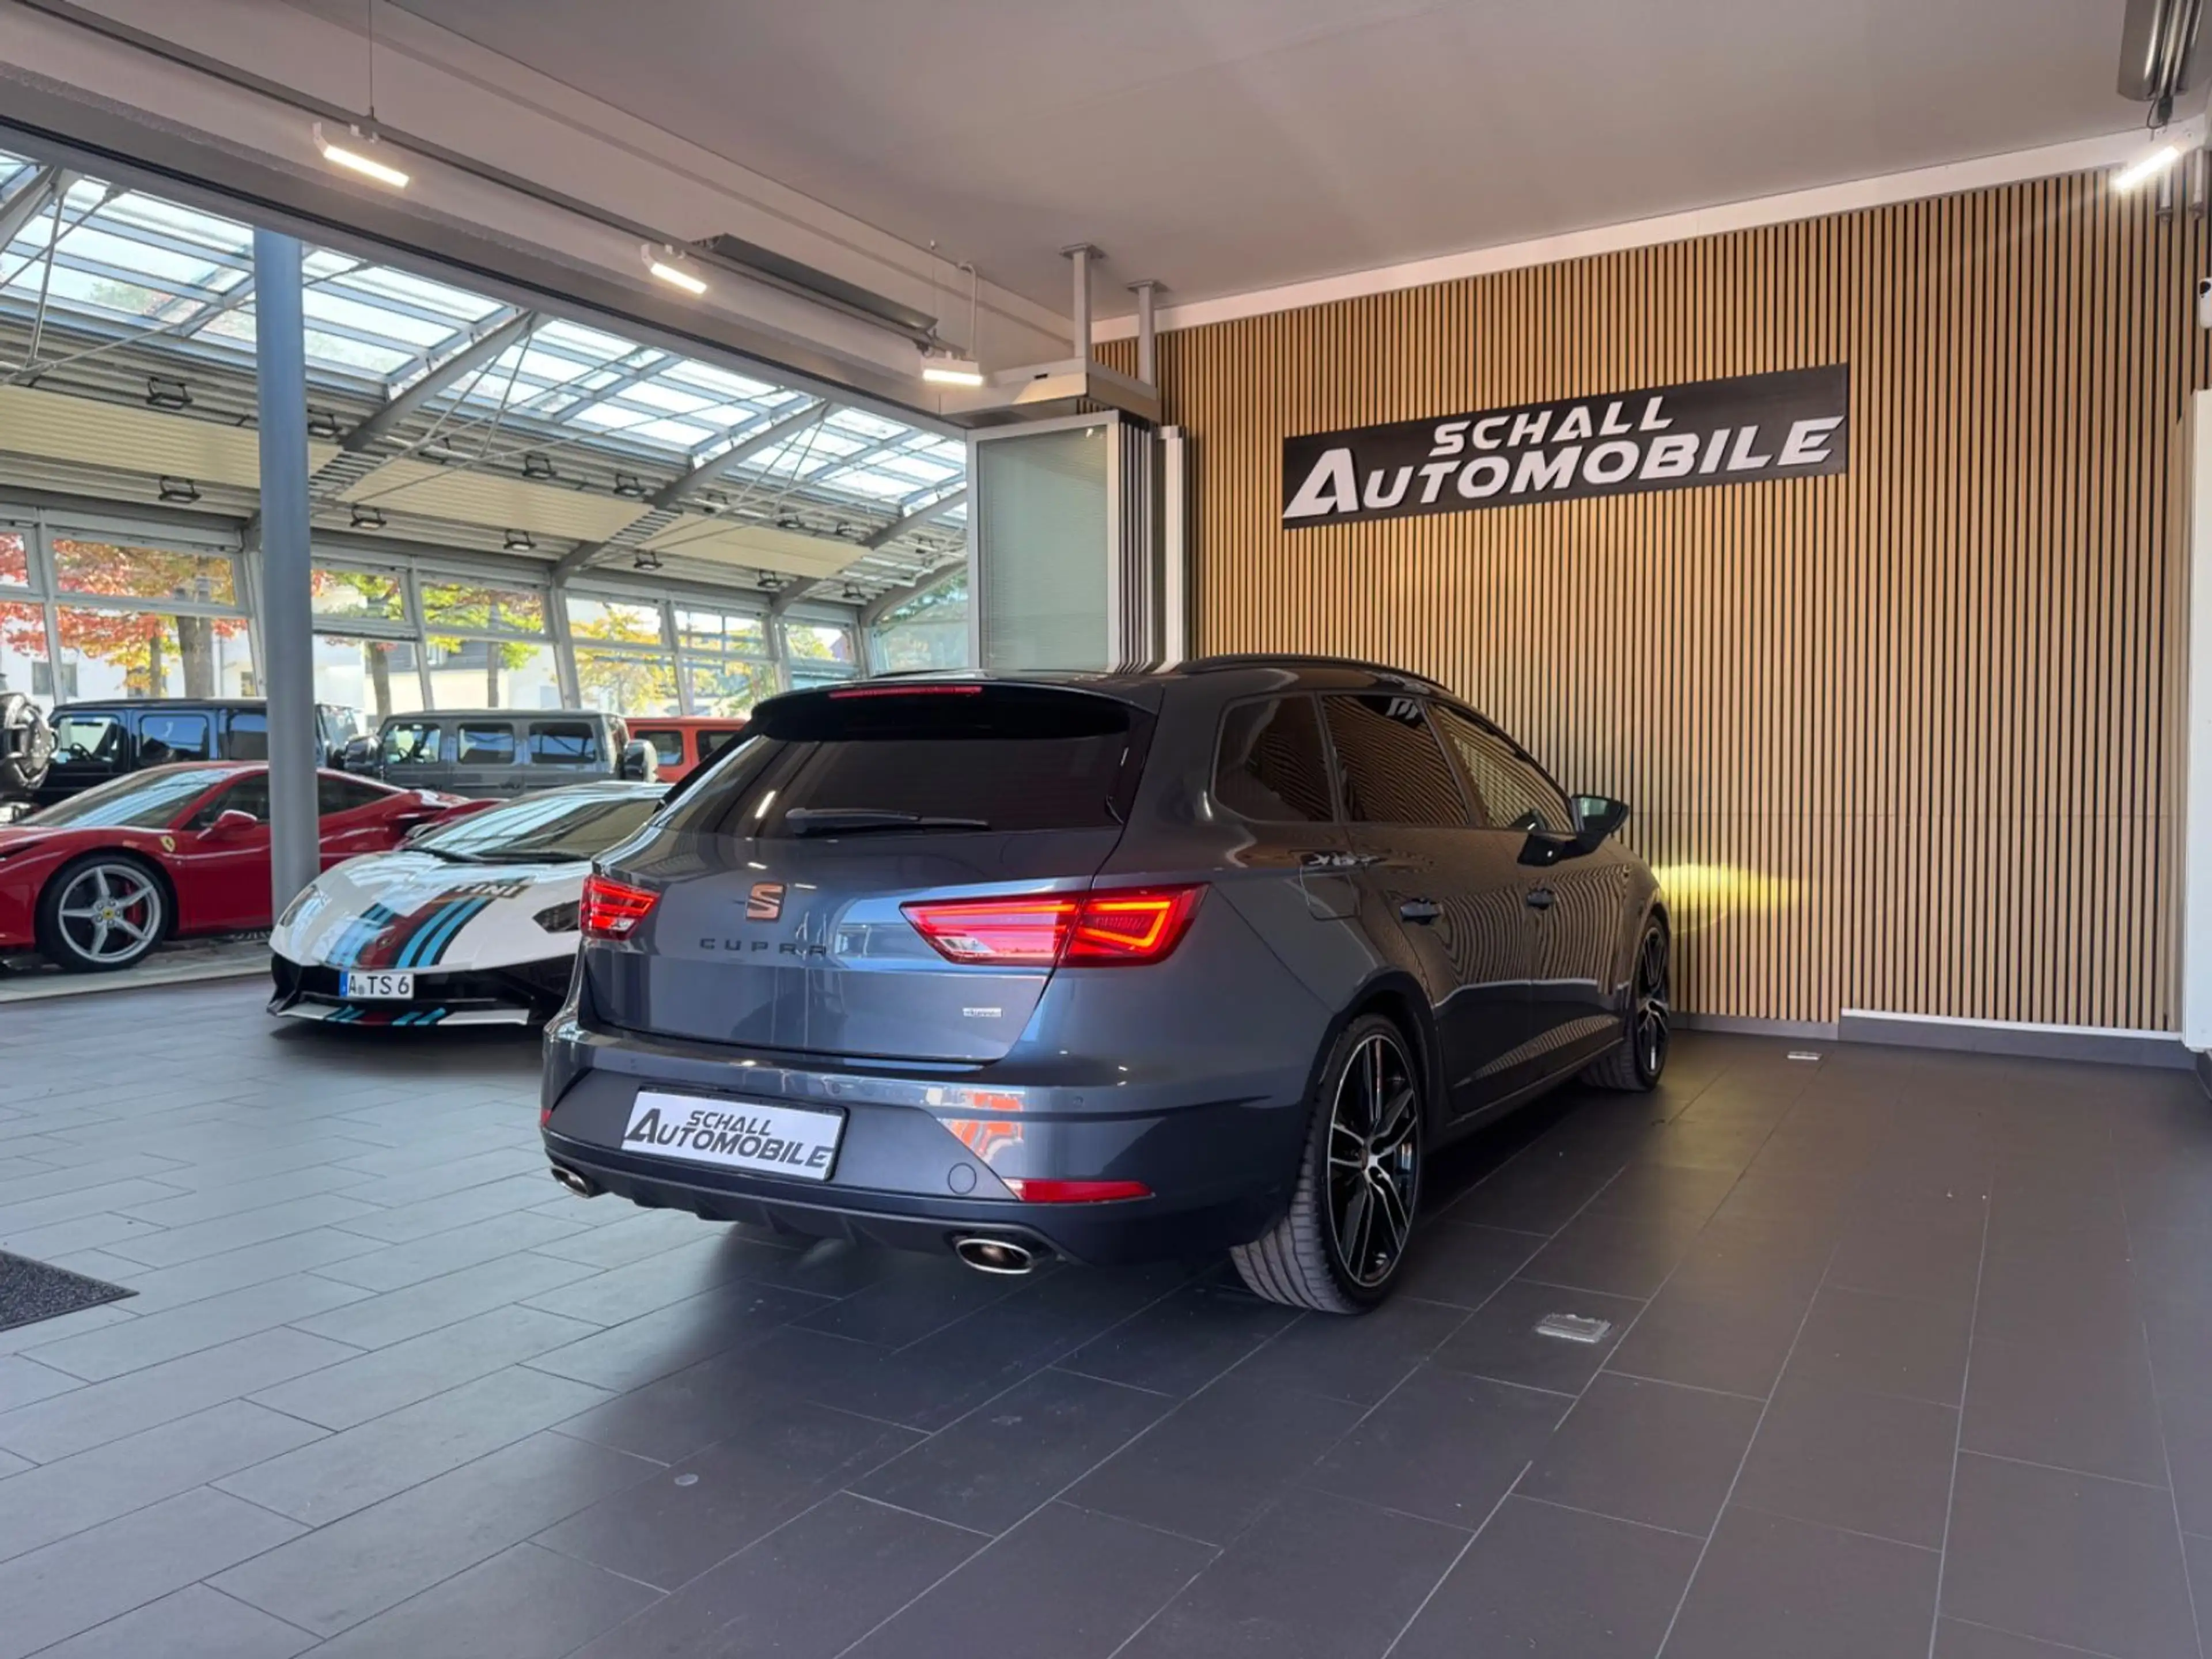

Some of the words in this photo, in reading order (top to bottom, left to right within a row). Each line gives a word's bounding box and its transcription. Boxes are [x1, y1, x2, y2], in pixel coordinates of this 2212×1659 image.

[1428, 395, 1673, 457] SCHALL
[1282, 414, 1844, 518] AUTOMOBILE
[699, 938, 827, 956] CUPRA
[349, 975, 357, 994] A
[367, 976, 392, 995] TS
[398, 976, 410, 995] 6
[625, 1108, 835, 1168] AUTOMOBILE
[687, 1110, 772, 1136] SCHALL
